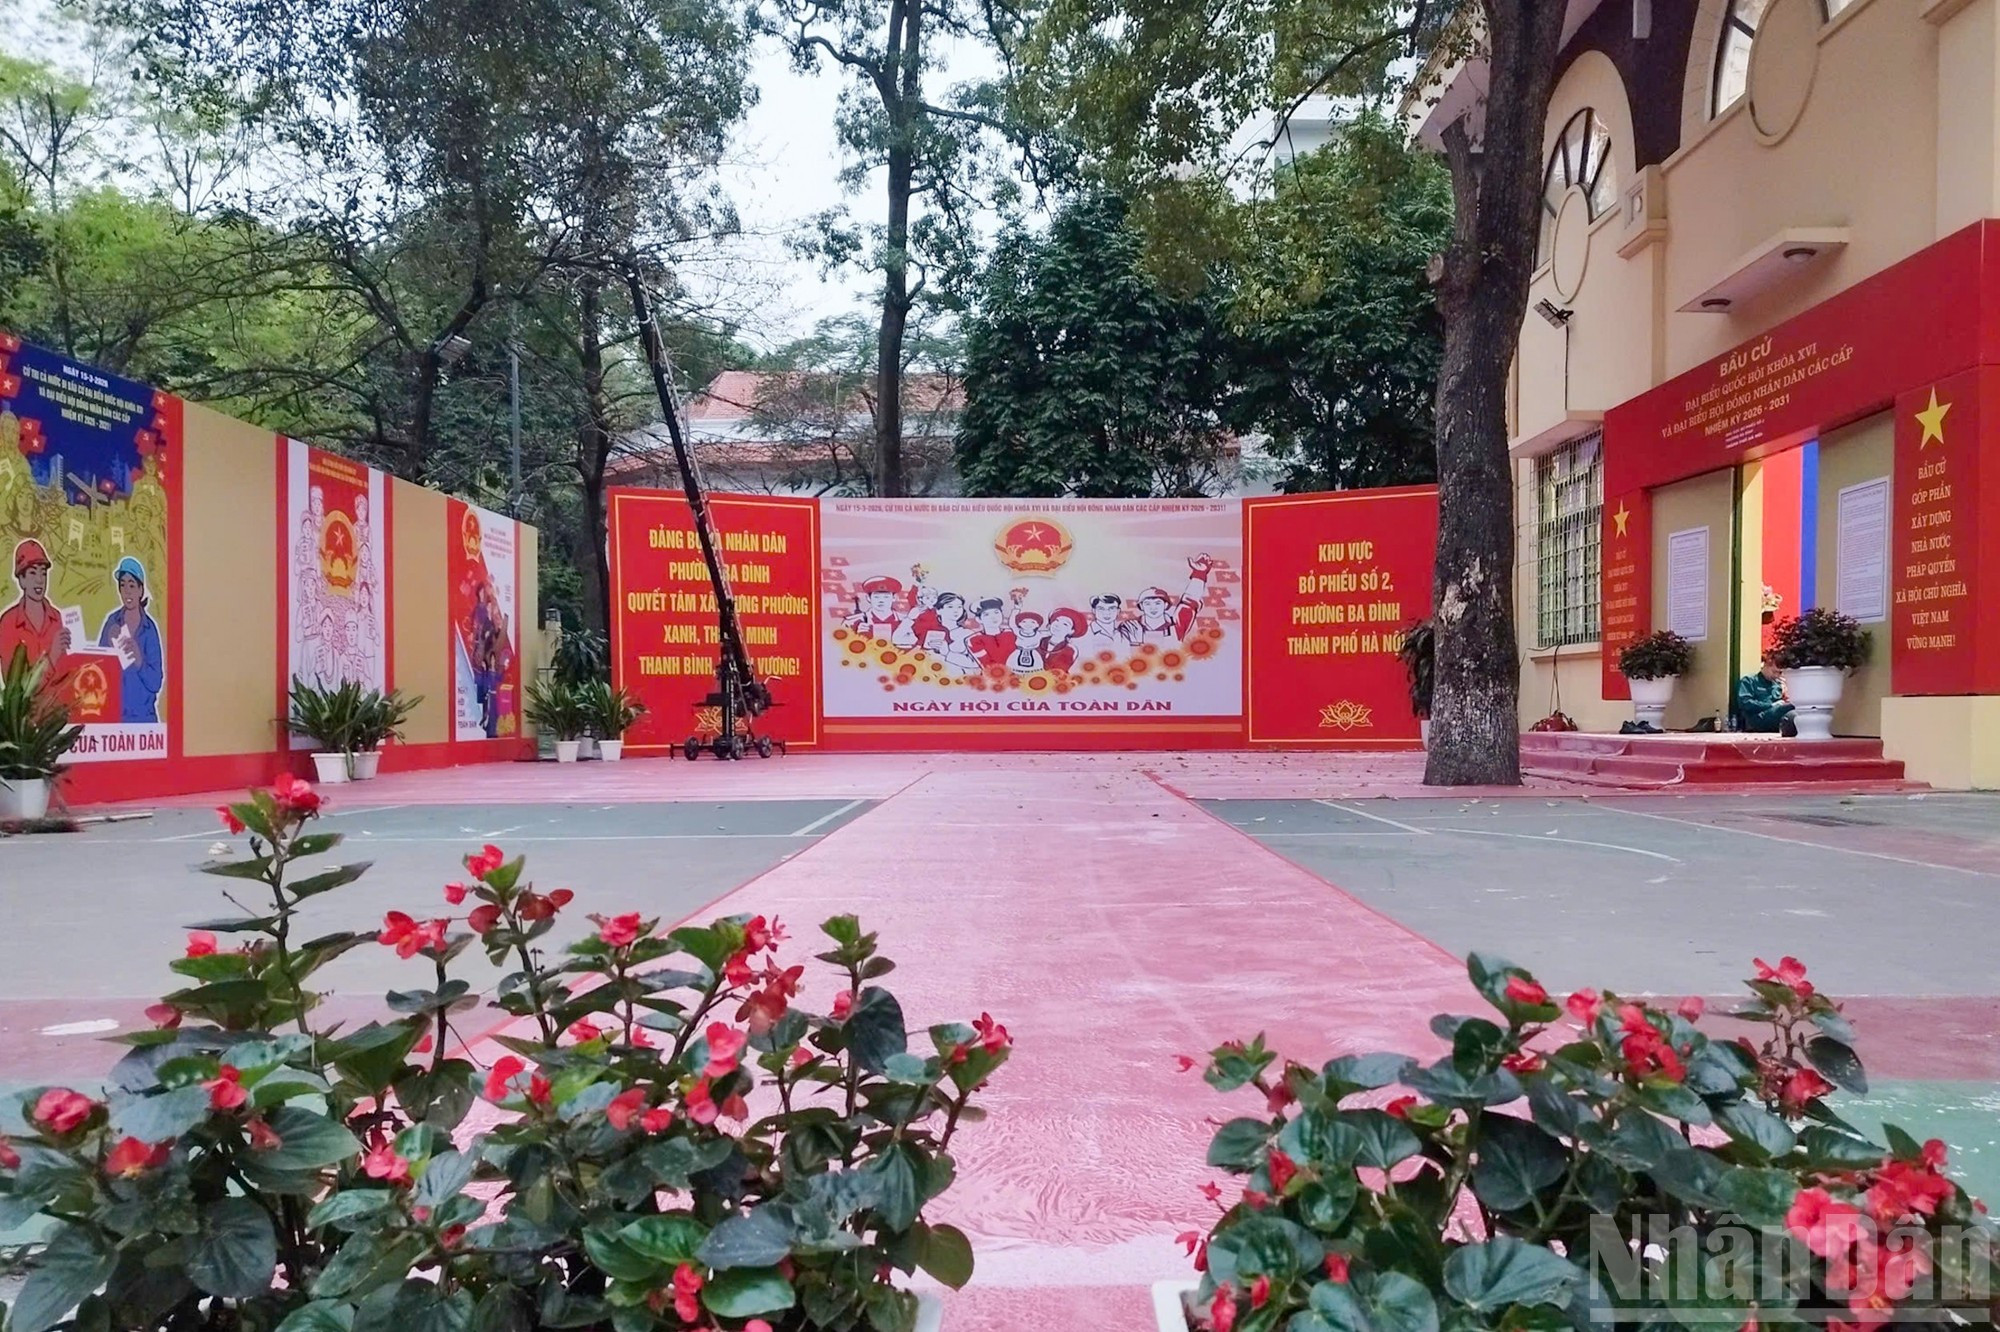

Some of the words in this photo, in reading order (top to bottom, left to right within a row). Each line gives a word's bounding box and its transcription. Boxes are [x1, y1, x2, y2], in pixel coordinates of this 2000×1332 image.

[1720, 351, 1747, 377] BẦU
[1751, 335, 1773, 361] CỬ
[1722, 373, 1746, 395] QUỐC
[1797, 342, 1818, 361] XVI
[1662, 423, 1673, 438] VÀ
[1783, 368, 1805, 387] DÂN
[1808, 357, 1829, 376] CÁC
[1831, 343, 1854, 366] CẤP
[1705, 419, 1729, 436] NHIỆM
[1730, 411, 1741, 426] KỲ
[1743, 405, 1763, 421] 2026
[1769, 393, 1790, 411] 2031
[1918, 460, 1934, 480] BẦU
[1935, 456, 1947, 475] CỬ
[1911, 488, 1928, 505] GÓP
[1929, 480, 1952, 501] PHẦN
[1911, 513, 1928, 529] XÂY
[1929, 510, 1951, 527] DỰNG
[649, 524, 683, 549] ĐẢNG
[726, 530, 759, 551] NHÂN
[762, 531, 786, 553] DÂN
[1911, 536, 1928, 553] NHÀ
[1929, 532, 1951, 550] NƯỚC
[1318, 543, 1344, 562] KHU
[1348, 540, 1373, 564] VỰC
[669, 558, 713, 581] PHƯỜN
[742, 561, 770, 583] ĐÌNH
[1299, 569, 1315, 594] BỎ
[1319, 567, 1357, 593] PHIẾU
[1361, 566, 1379, 591] SỐ
[1382, 572, 1394, 592] 2,
[1906, 562, 1926, 578] PHÁP
[628, 588, 666, 612] QUYẾT
[669, 589, 696, 612] TÂM
[700, 590, 720, 612] XÂ
[734, 594, 759, 616] ỰNG
[762, 593, 808, 615] PHƯỜNG
[1923, 581, 1939, 600] CHỦ
[1292, 602, 1344, 624] PHƯỜNG
[1348, 604, 1365, 622] BA
[1369, 600, 1400, 622] ĐÌNH
[1911, 609, 1929, 627] VIỆT
[1931, 610, 1949, 624] NAM
[664, 625, 700, 646] XANH,
[746, 626, 777, 645] MINH
[1287, 633, 1328, 655] THÀNH
[1332, 629, 1358, 654] PHỐ
[1362, 631, 1379, 653] HÀ
[1929, 634, 1956, 651] MẠNH!
[639, 656, 680, 674] THANH
[684, 653, 716, 677] BÌNH,
[893, 699, 951, 711] NGÀY
[960, 699, 999, 713] HỘI
[1007, 698, 1050, 711] CỦA
[1058, 699, 1118, 711] TOÀN
[1127, 699, 1171, 711] DÂN
[101, 731, 135, 752] TOÀN
[139, 730, 164, 751] DÂN
